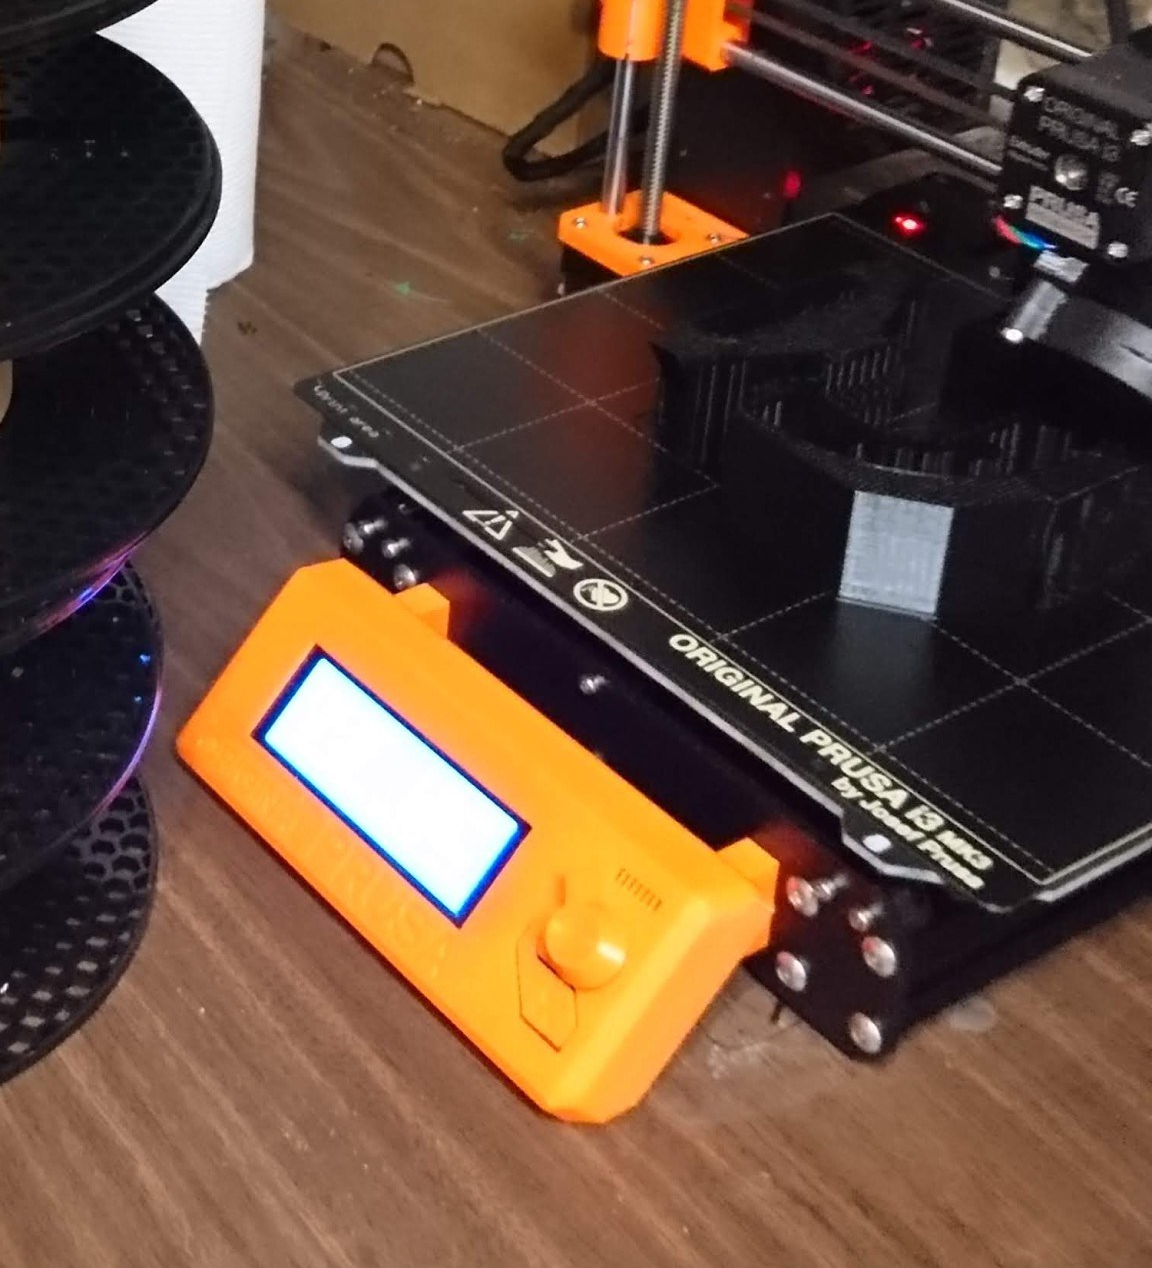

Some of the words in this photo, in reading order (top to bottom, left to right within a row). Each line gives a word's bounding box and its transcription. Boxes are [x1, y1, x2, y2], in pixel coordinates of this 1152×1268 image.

[668, 633, 801, 733] ORIGINAL
[798, 729, 909, 811] PRUSA
[831, 775, 864, 799] by
[859, 791, 925, 842] Josef
[918, 839, 986, 890] Prusa
